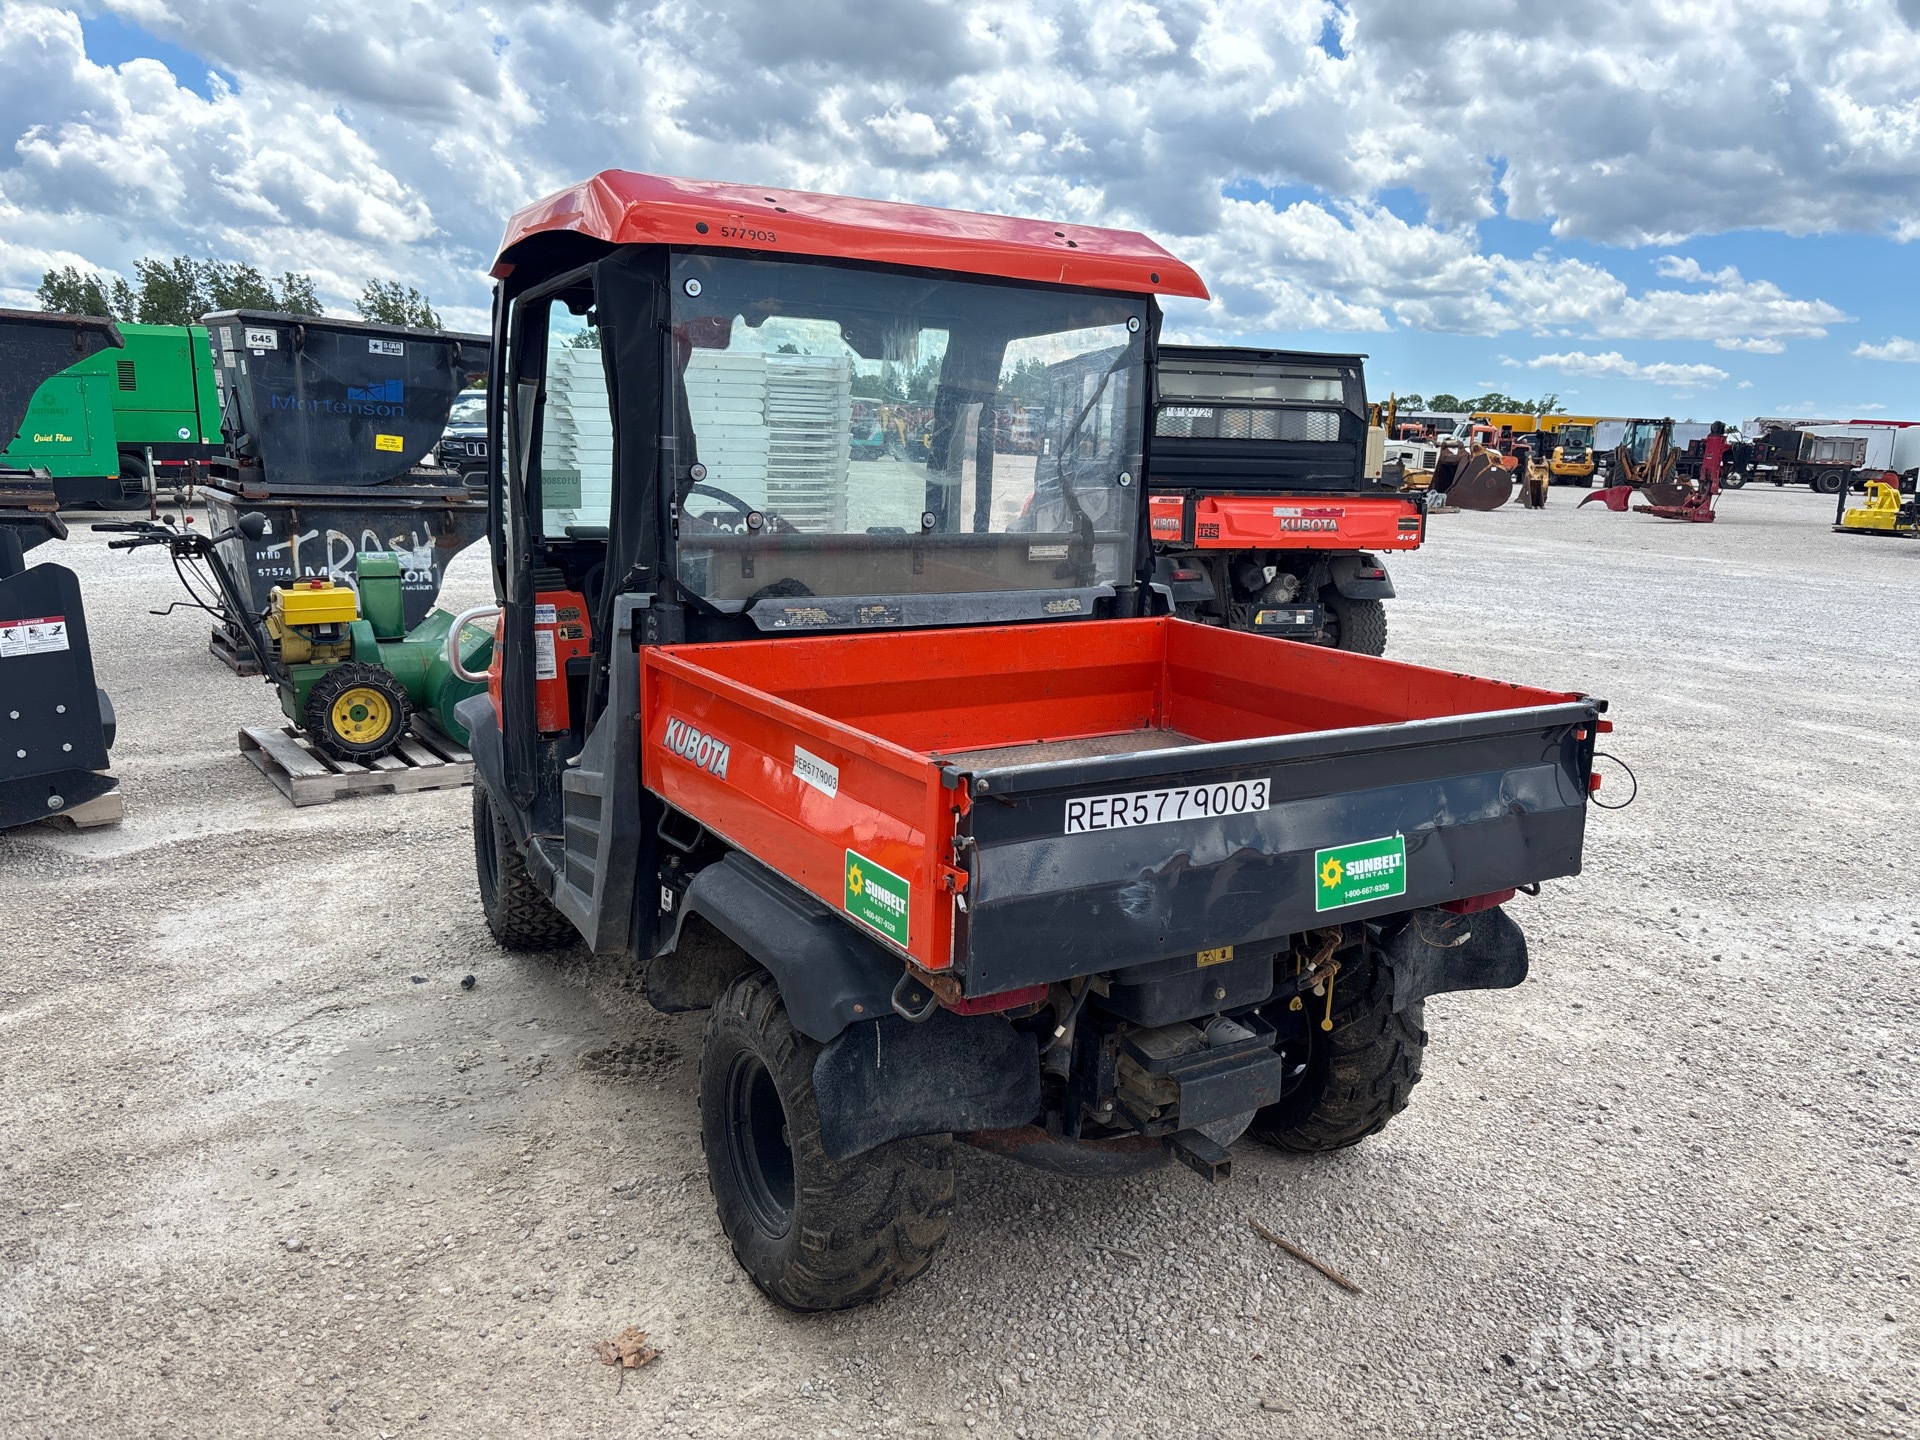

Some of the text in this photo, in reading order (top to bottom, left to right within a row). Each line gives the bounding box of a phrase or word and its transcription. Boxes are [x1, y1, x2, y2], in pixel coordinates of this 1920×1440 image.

[721, 226, 777, 243] 577903
[251, 334, 272, 343] 645
[271, 393, 405, 417] Mortenson
[33, 433, 73, 443] Quiet Flow
[1152, 517, 1180, 531] KUBOTA
[1198, 528, 1219, 537] IRS
[1280, 518, 1339, 532] KUBOTA
[1396, 533, 1417, 541] 4x4
[258, 567, 292, 577] 57574
[662, 715, 731, 780] KUBOTA
[794, 755, 838, 790] RER5779003
[1066, 780, 1267, 832] RER5779003
[1345, 854, 1402, 876] SUNBELT
[1353, 867, 1395, 881] RENTALS
[865, 879, 907, 913] SUNBELT
[1343, 882, 1390, 900] 1-800-667-9328
[870, 896, 900, 918] RENTALS
[862, 907, 896, 933] 1-800-667-9328
